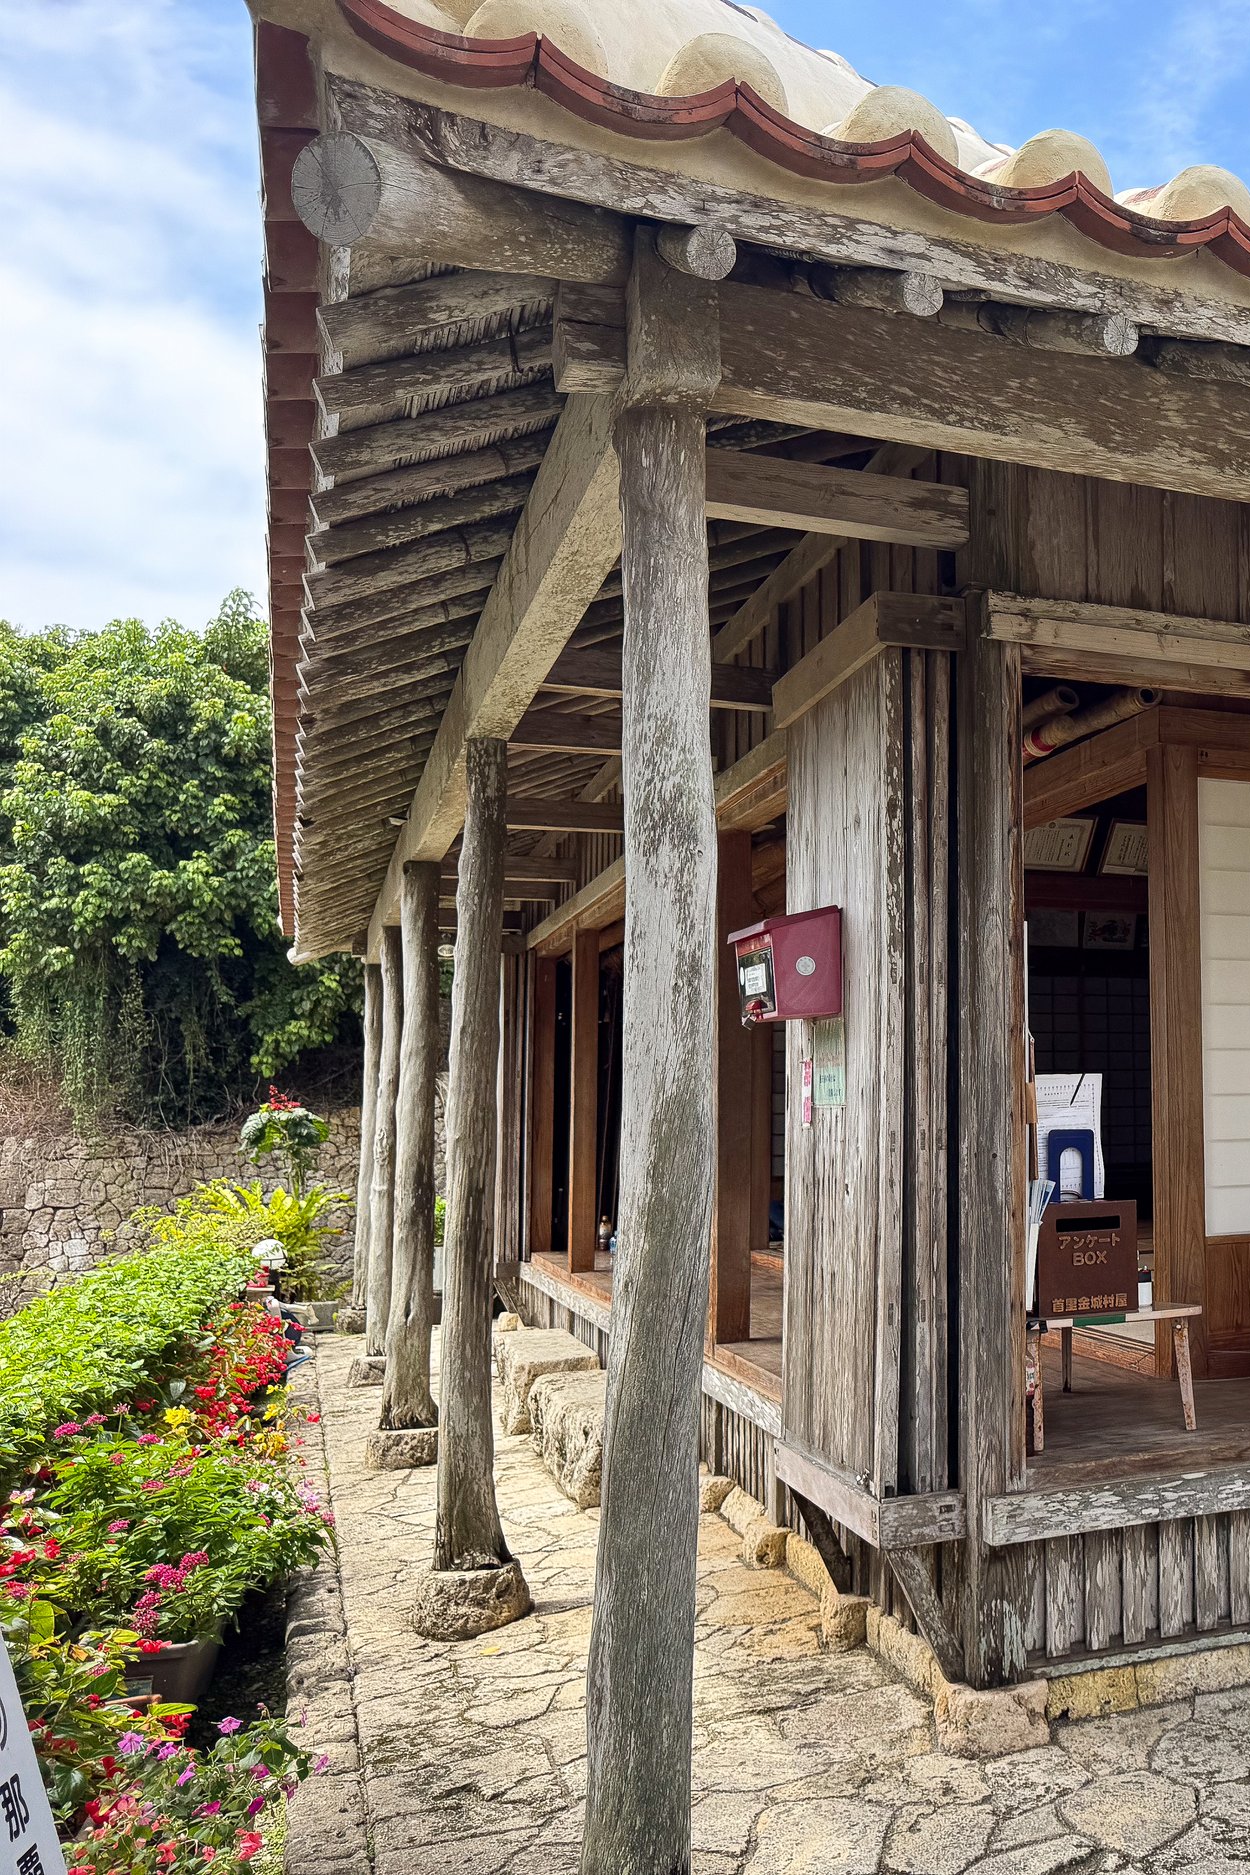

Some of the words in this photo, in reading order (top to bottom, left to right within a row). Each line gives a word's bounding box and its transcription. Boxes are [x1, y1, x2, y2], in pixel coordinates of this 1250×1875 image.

[1058, 1232, 1120, 1250] アンケート
[1072, 1250, 1108, 1266] BOX
[1052, 1292, 1128, 1313] 首里金城村屋
